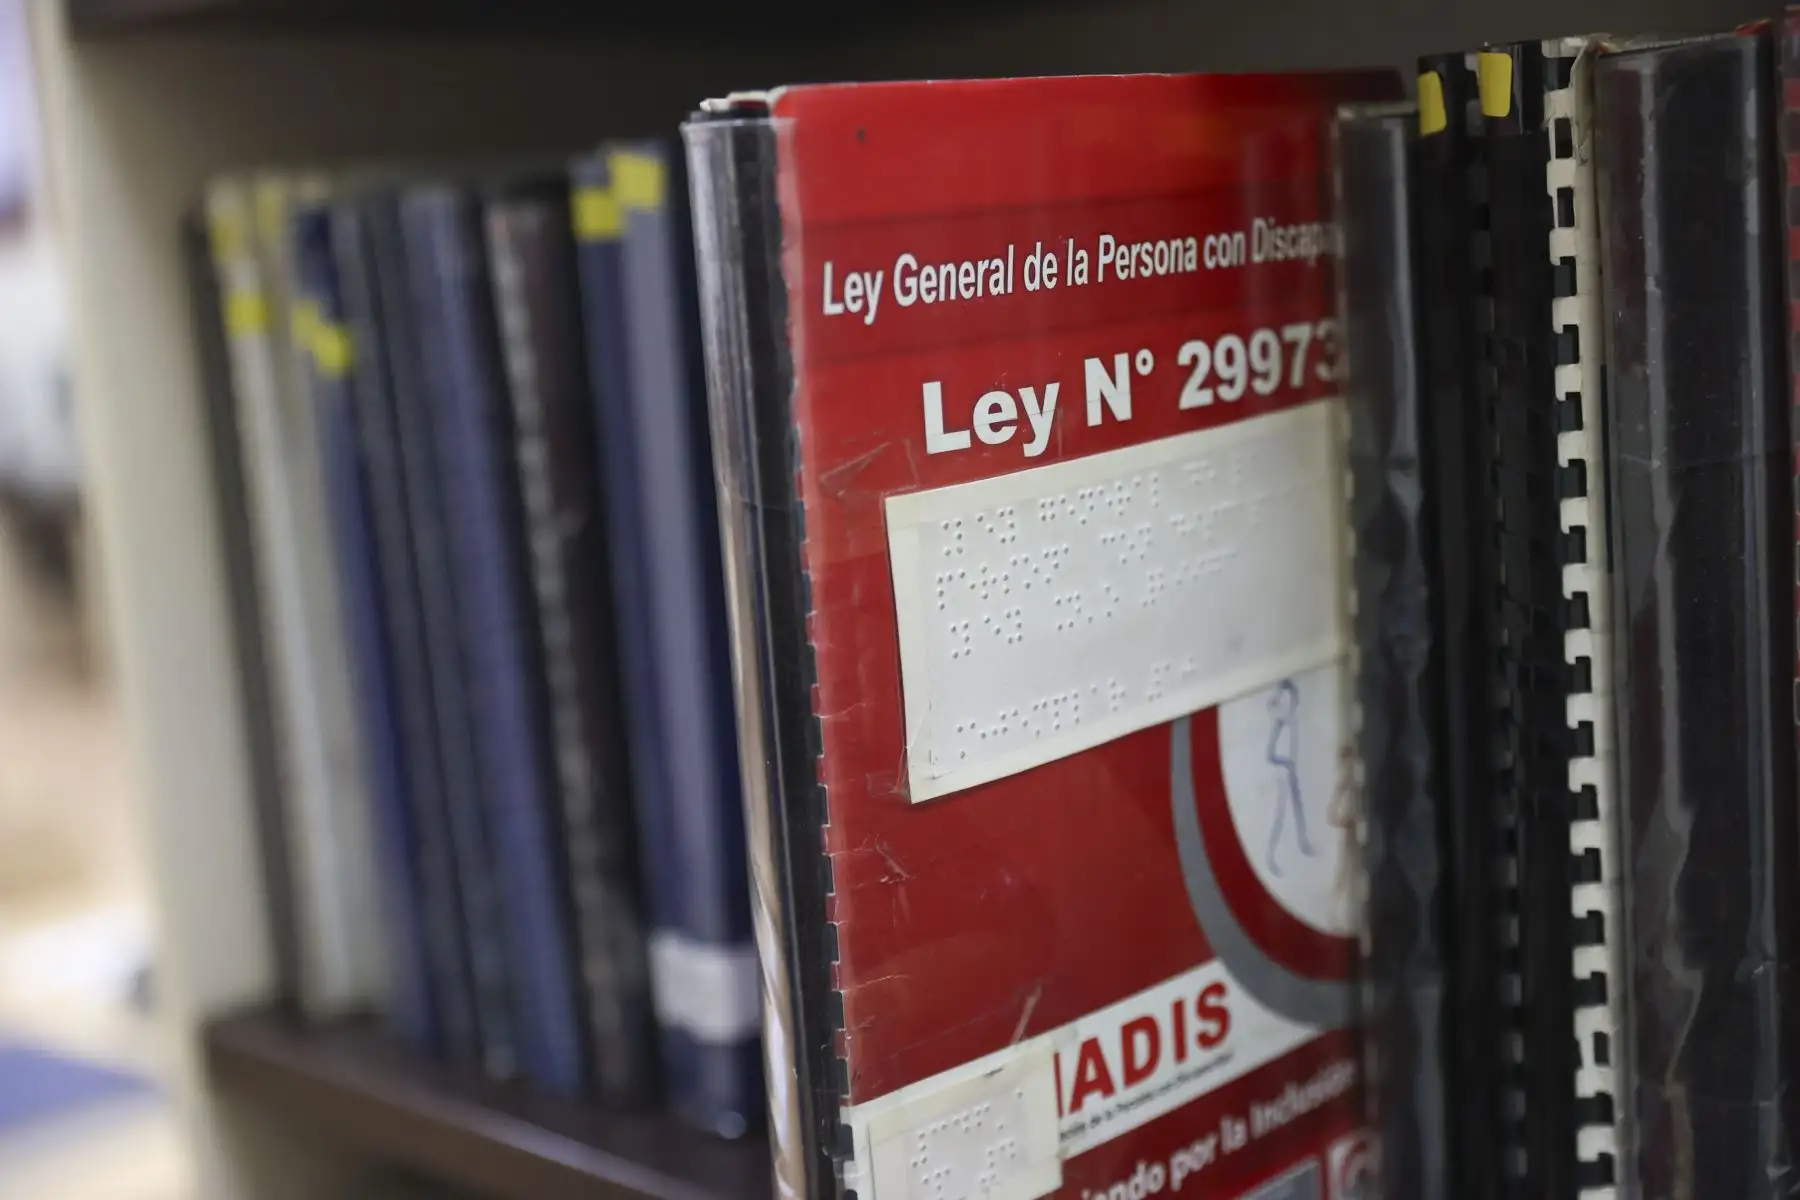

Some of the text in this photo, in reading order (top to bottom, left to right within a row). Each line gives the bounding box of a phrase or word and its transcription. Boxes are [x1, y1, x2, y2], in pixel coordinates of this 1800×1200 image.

[822, 260, 884, 325] Ley
[892, 252, 1014, 307] General
[1023, 241, 1058, 291] de
[1066, 238, 1089, 286] la
[1097, 234, 1197, 283] Persona
[1203, 231, 1246, 270] con
[922, 380, 1060, 457] Ley
[1084, 348, 1155, 426] N°
[1053, 981, 1231, 1117] ADIS
[1169, 1133, 1218, 1192] por
[1221, 1113, 1247, 1155] la
